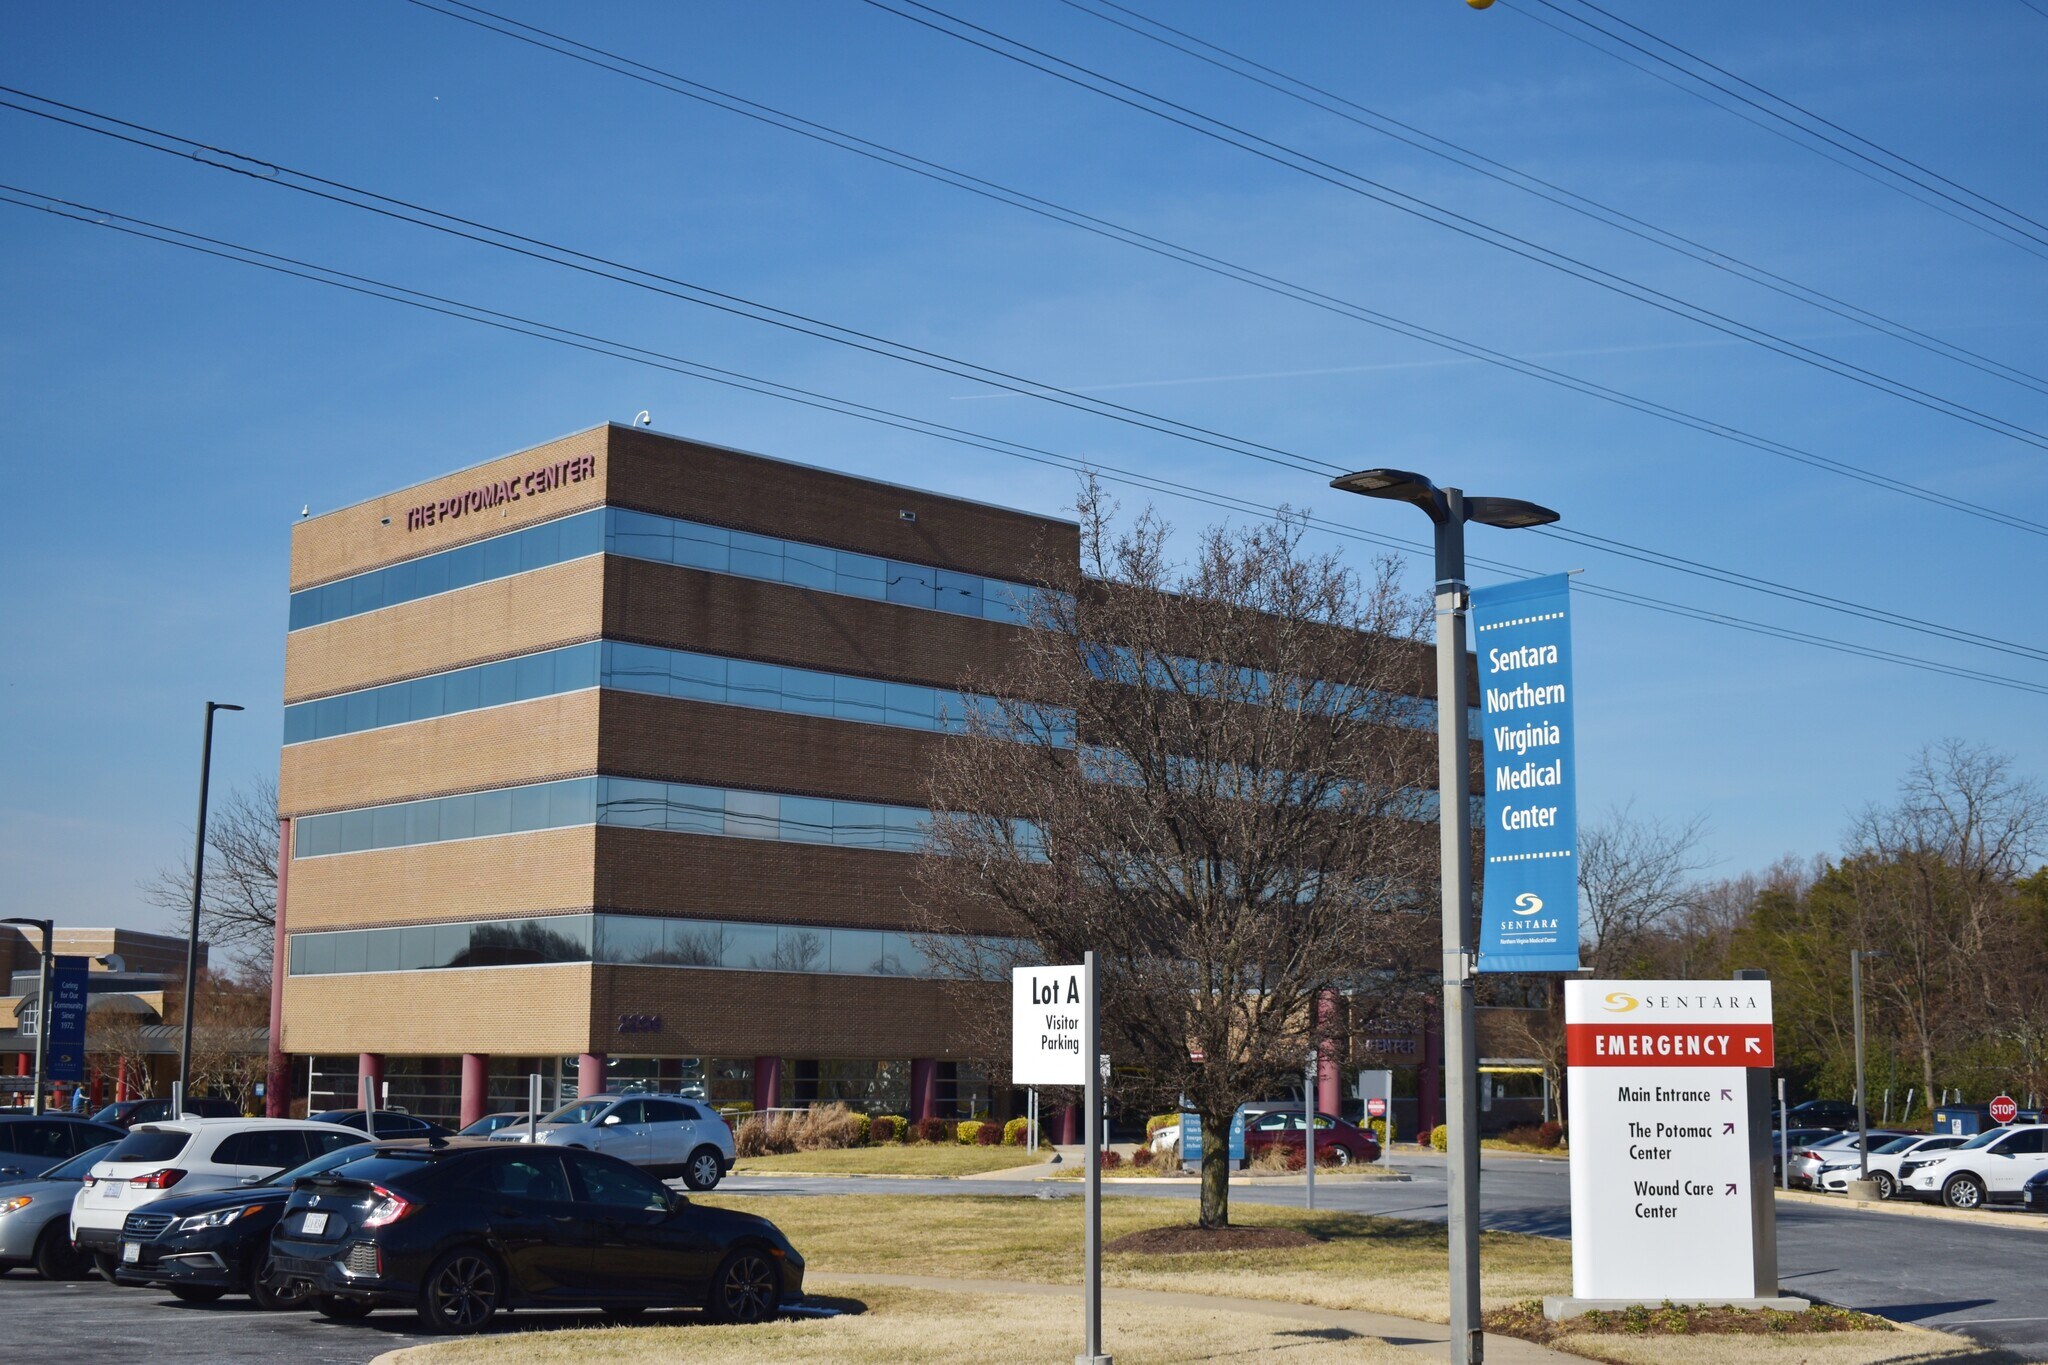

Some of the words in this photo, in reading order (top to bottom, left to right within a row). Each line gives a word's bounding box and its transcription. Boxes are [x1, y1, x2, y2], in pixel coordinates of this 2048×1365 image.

[405, 503, 435, 531] THE
[438, 476, 521, 522] POTOMAC
[524, 454, 595, 496] CENTER
[1489, 644, 1558, 674] Sentara
[1486, 682, 1565, 713] Northern
[1494, 720, 1560, 755] Virginia
[1496, 759, 1561, 792] Medical
[1501, 805, 1557, 831] Center
[1500, 919, 1558, 930] SENTARA
[61, 981, 79, 991] Caring
[1032, 976, 1059, 1004] Lot
[1066, 975, 1080, 1004] A
[54, 1001, 84, 1011] Community
[1646, 996, 1757, 1009] SENTARA
[61, 1011, 75, 1019] Since
[1045, 1014, 1079, 1030] Visitor
[1041, 1033, 1079, 1055] Parking
[1595, 1035, 1730, 1056] EMERGENCY
[1618, 1086, 1650, 1102] Main
[1655, 1086, 1711, 1102] Entrance
[1991, 1104, 2015, 1115] STOP
[1628, 1122, 1651, 1138] The
[1656, 1122, 1713, 1138] Potomac
[1629, 1144, 1672, 1160] Center
[1634, 1180, 1679, 1196] Wound
[1684, 1180, 1714, 1196] Care
[1635, 1203, 1678, 1218] Center
